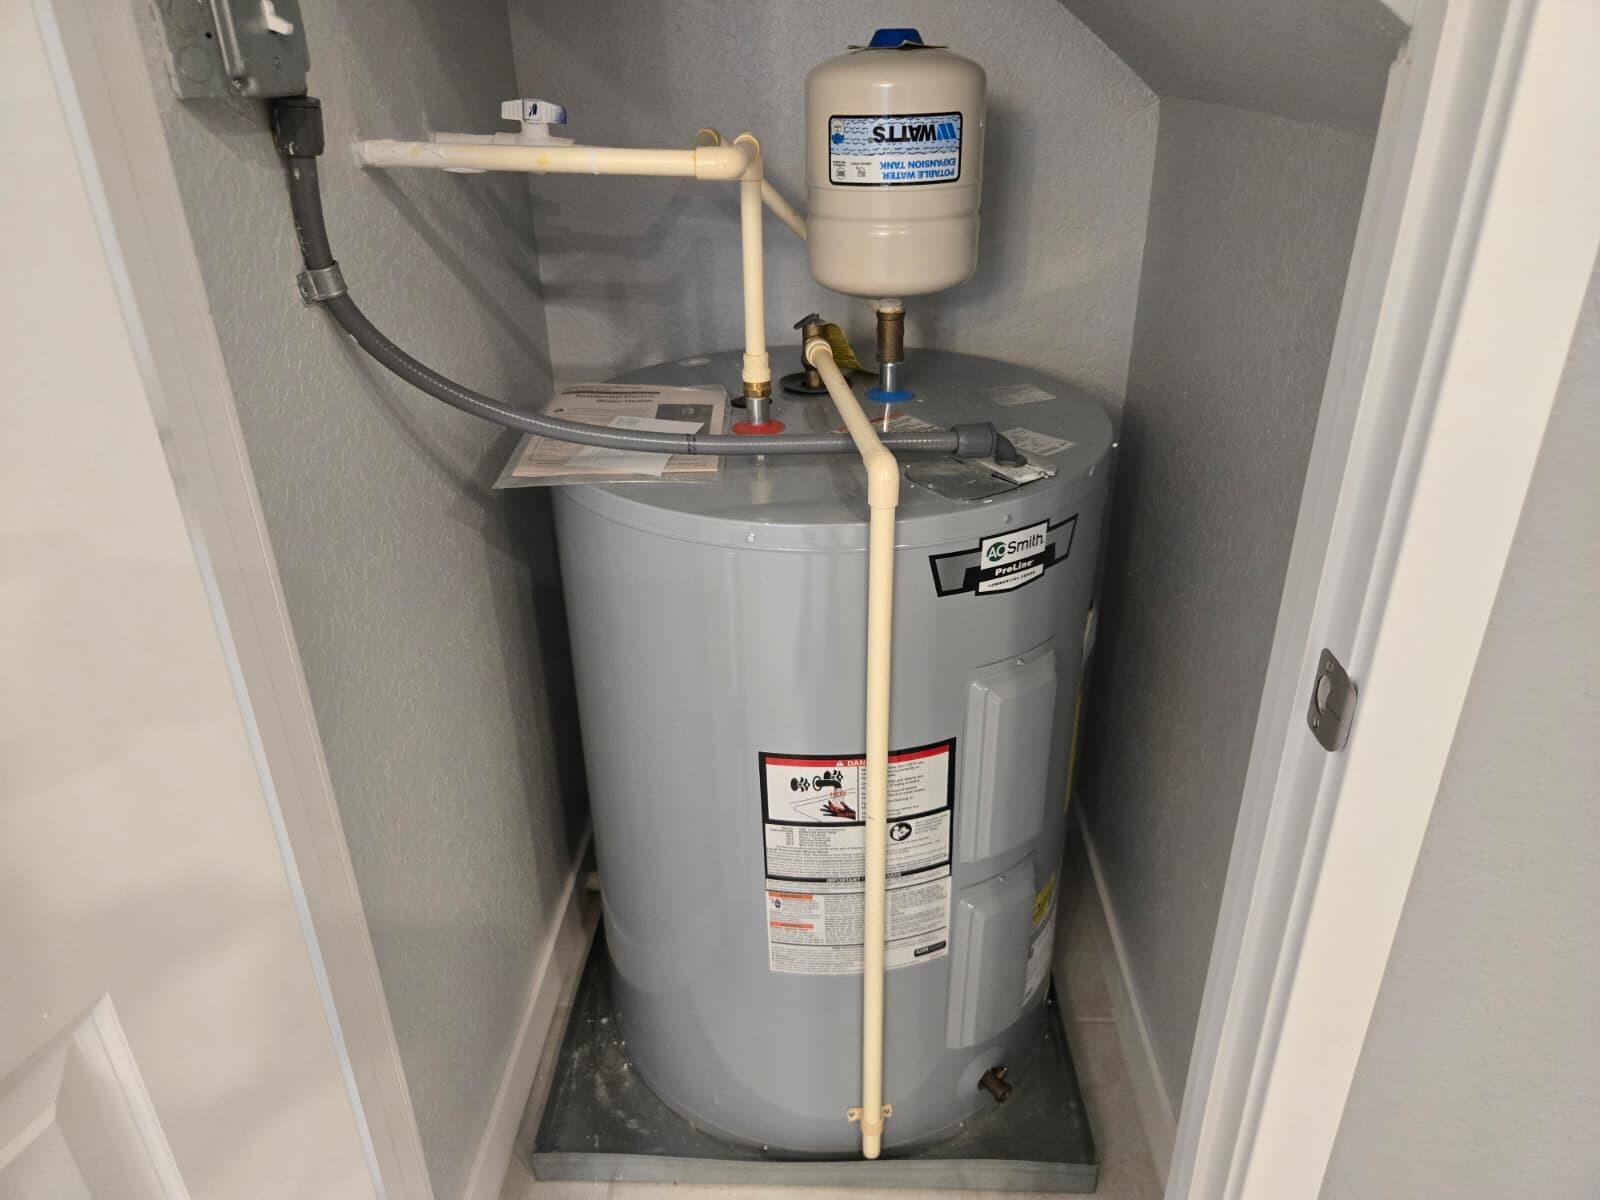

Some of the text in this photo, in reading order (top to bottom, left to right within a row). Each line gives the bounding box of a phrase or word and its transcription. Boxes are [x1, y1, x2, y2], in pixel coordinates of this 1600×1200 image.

[872, 124, 937, 143] WATTS
[880, 160, 906, 170] TANK
[908, 158, 956, 168] EXPANSION
[882, 168, 955, 180] POTABLE WATER
[1007, 534, 1043, 554] Smith
[995, 560, 1033, 577] ProLine
